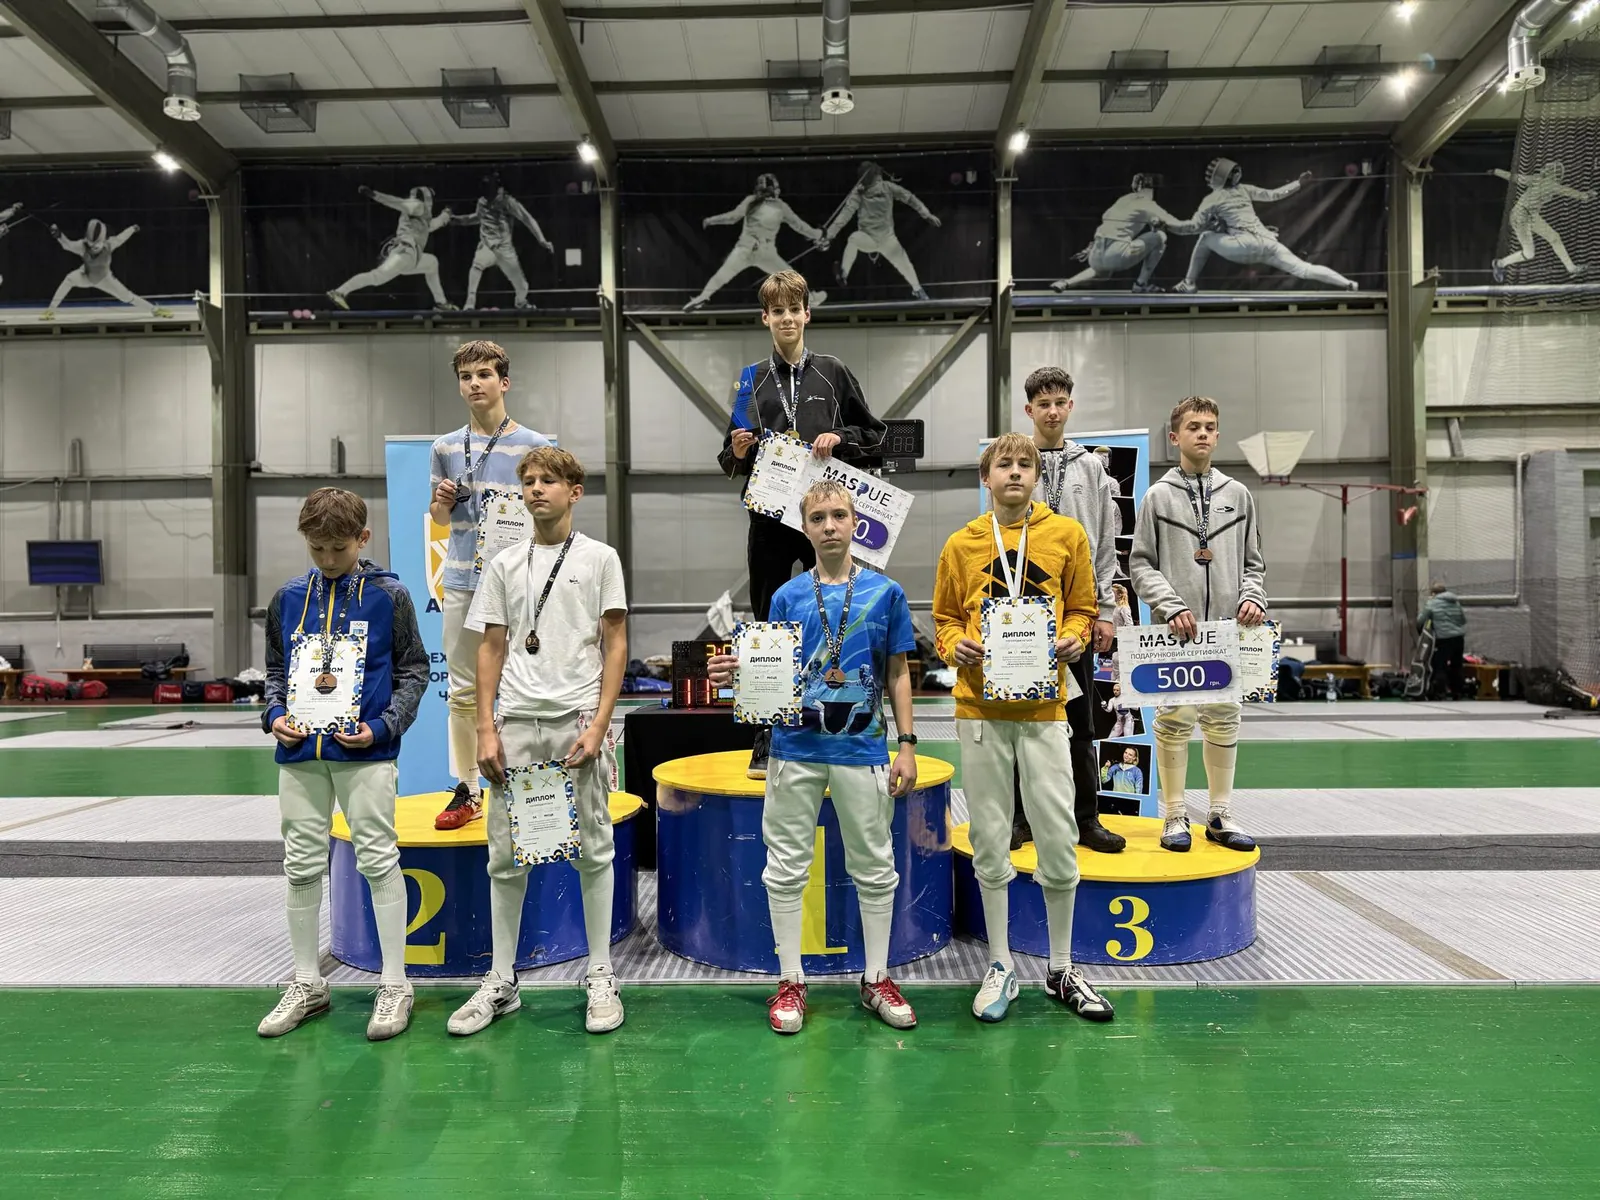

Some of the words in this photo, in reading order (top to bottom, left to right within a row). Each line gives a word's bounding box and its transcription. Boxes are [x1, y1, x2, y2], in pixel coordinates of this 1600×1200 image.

[771, 460, 796, 472] ДИПЛОМ
[859, 500, 893, 520] СЕРТИФІКАТ
[496, 519, 524, 527] ДИПЛОМ
[1130, 650, 1186, 660] ПОДАРУНКОВИЙ
[1187, 648, 1227, 657] СЕРТИФІКАТ
[1157, 665, 1206, 689] 500
[525, 794, 556, 804] ДИПЛОМ
[400, 868, 446, 965] 2
[1105, 895, 1154, 961] 3
